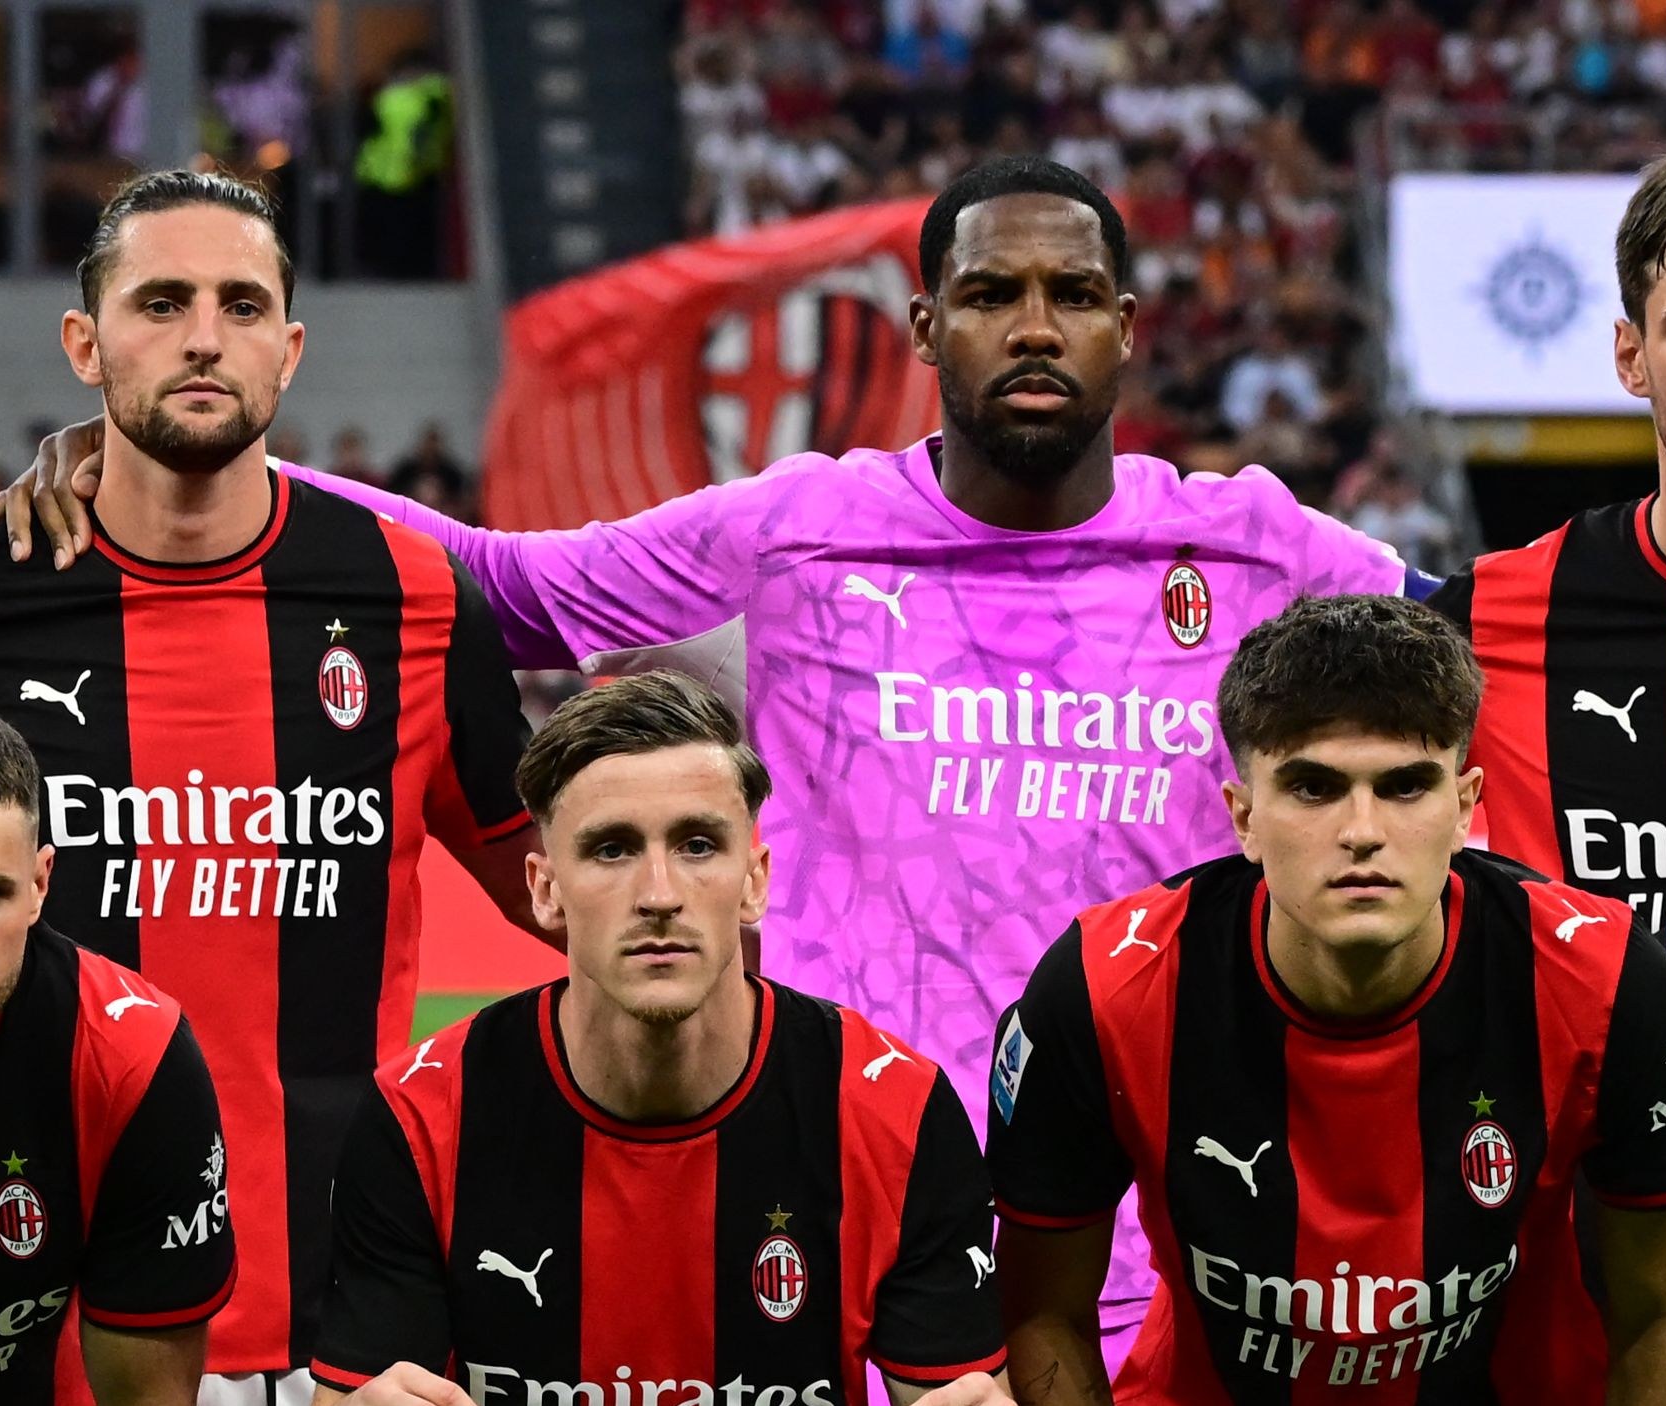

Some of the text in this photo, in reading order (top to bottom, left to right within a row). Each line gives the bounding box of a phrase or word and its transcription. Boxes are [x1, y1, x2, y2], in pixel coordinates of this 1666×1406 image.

[1172, 570, 1197, 584] ACM
[1177, 628, 1200, 639] 1899
[329, 652, 354, 666] ACM
[334, 710, 356, 720] 1899
[874, 671, 1214, 757] Emirates
[928, 757, 1172, 825] FLY BETTER
[44, 769, 385, 847] Emirates
[100, 859, 341, 918] FLY BETTER
[1472, 1128, 1501, 1146] ACM
[2, 1187, 33, 1200] ACM
[1479, 1188, 1506, 1199] 1899
[161, 1190, 228, 1250] MS
[9, 1240, 36, 1251] 1899
[764, 1242, 796, 1257] ACM
[767, 1302, 795, 1313] 1899
[1238, 1307, 1482, 1387] FLY BETTER
